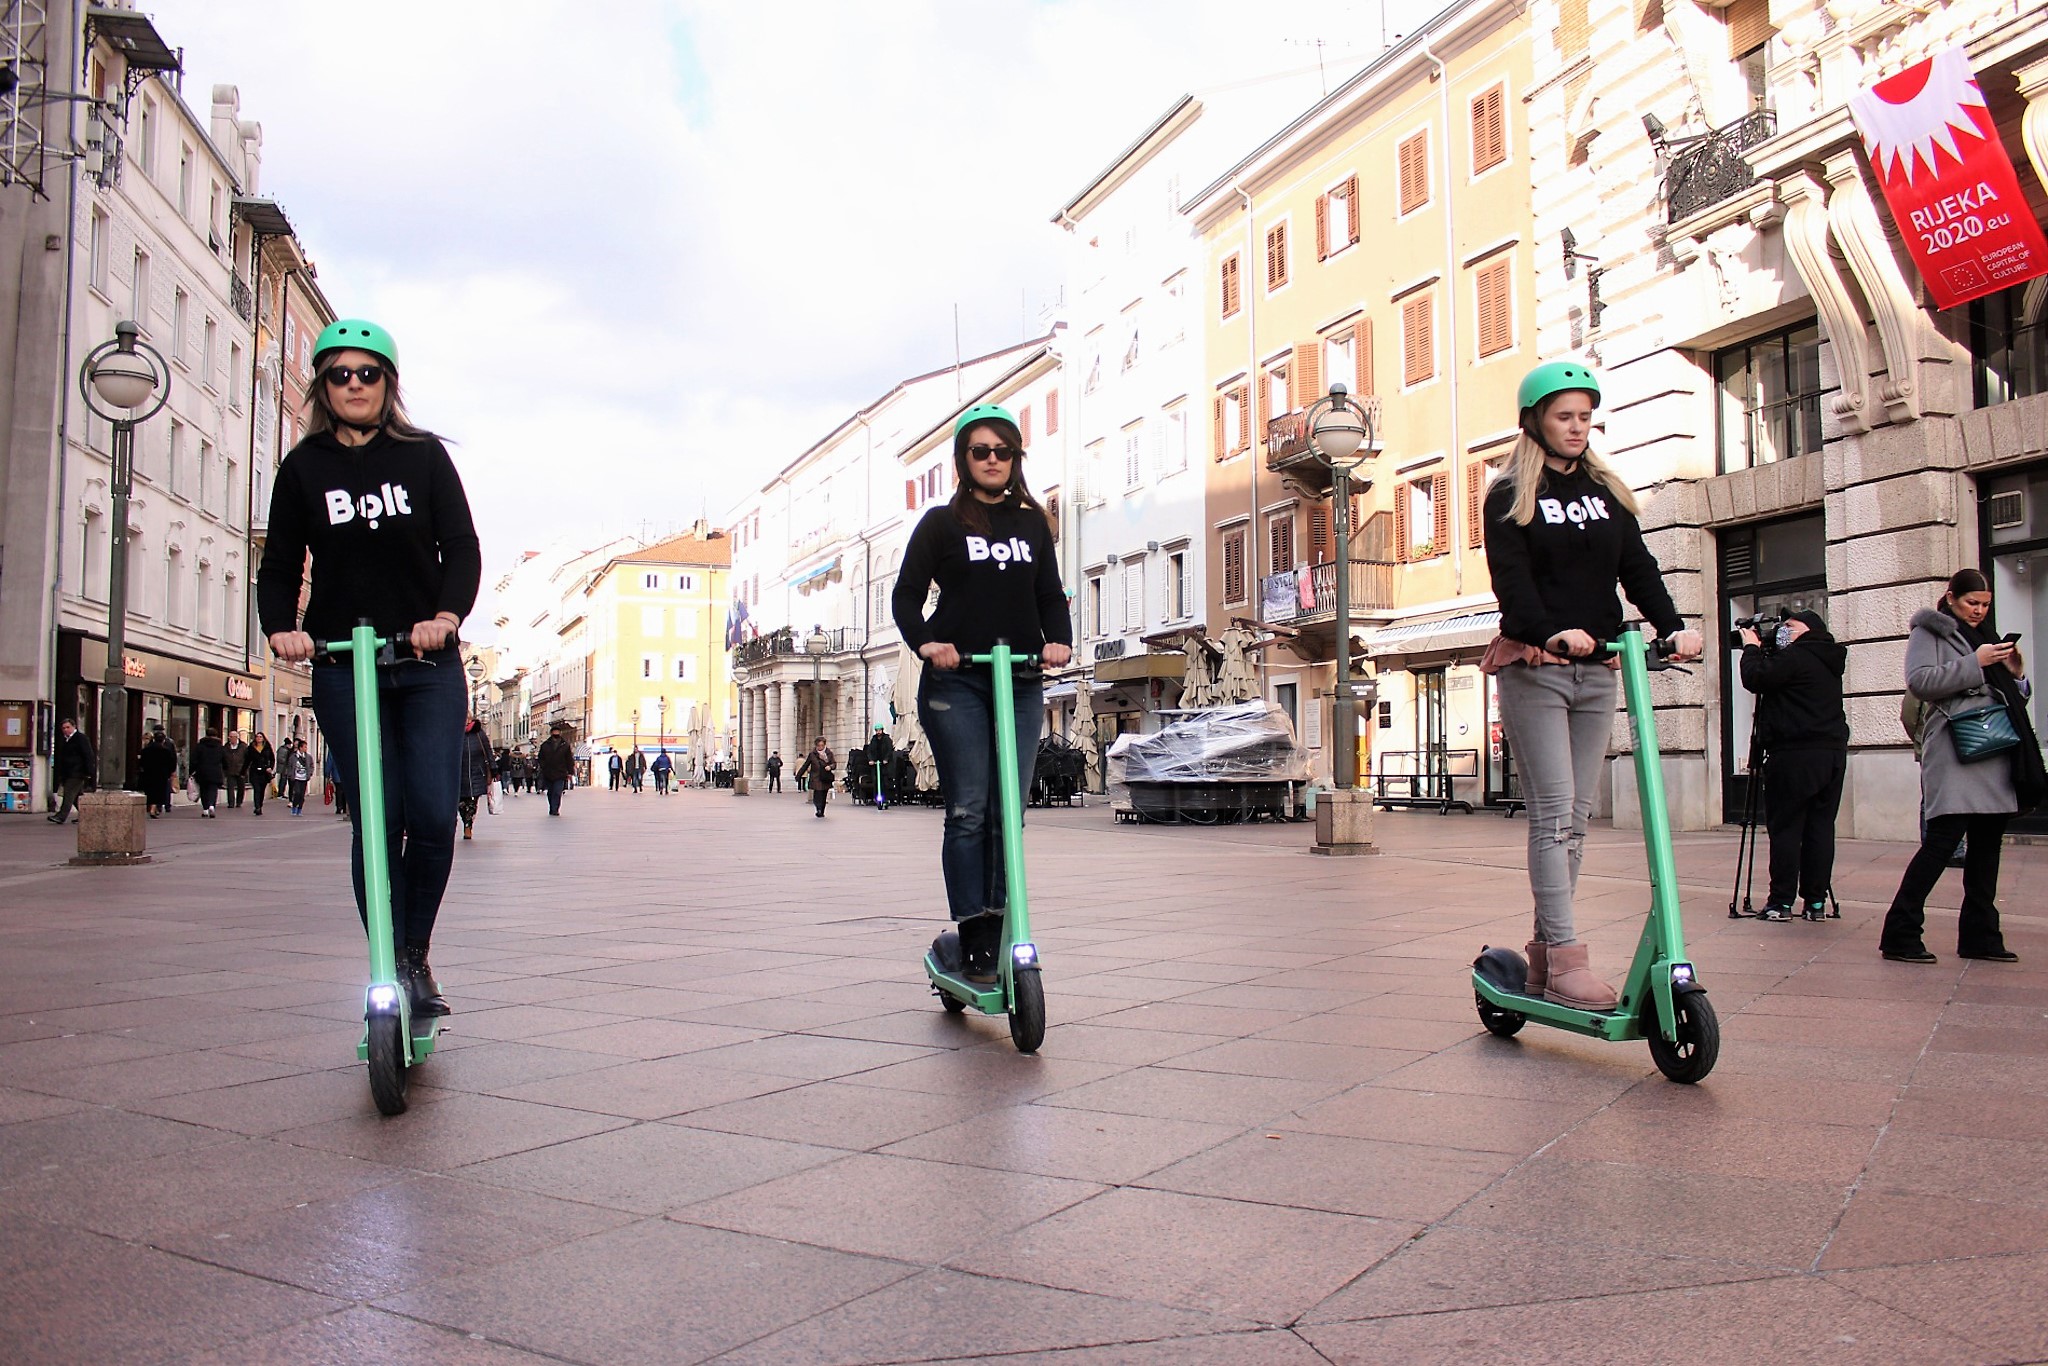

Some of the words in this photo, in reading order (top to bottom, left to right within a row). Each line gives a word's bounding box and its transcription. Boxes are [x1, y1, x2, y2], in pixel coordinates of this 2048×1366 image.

[1909, 182, 1999, 232] RIJEKA
[1920, 213, 2011, 255] 2020.eu
[1980, 241, 2025, 263] EUROPEAN
[1986, 255, 2020, 272] CAPITAL
[2018, 249, 2031, 261] OF
[1992, 262, 2029, 280] CULTURE
[325, 482, 412, 529] Bolt
[1538, 495, 1610, 529] Bolt
[966, 535, 1032, 570] Bolt
[1262, 574, 1293, 590] OSTEL
